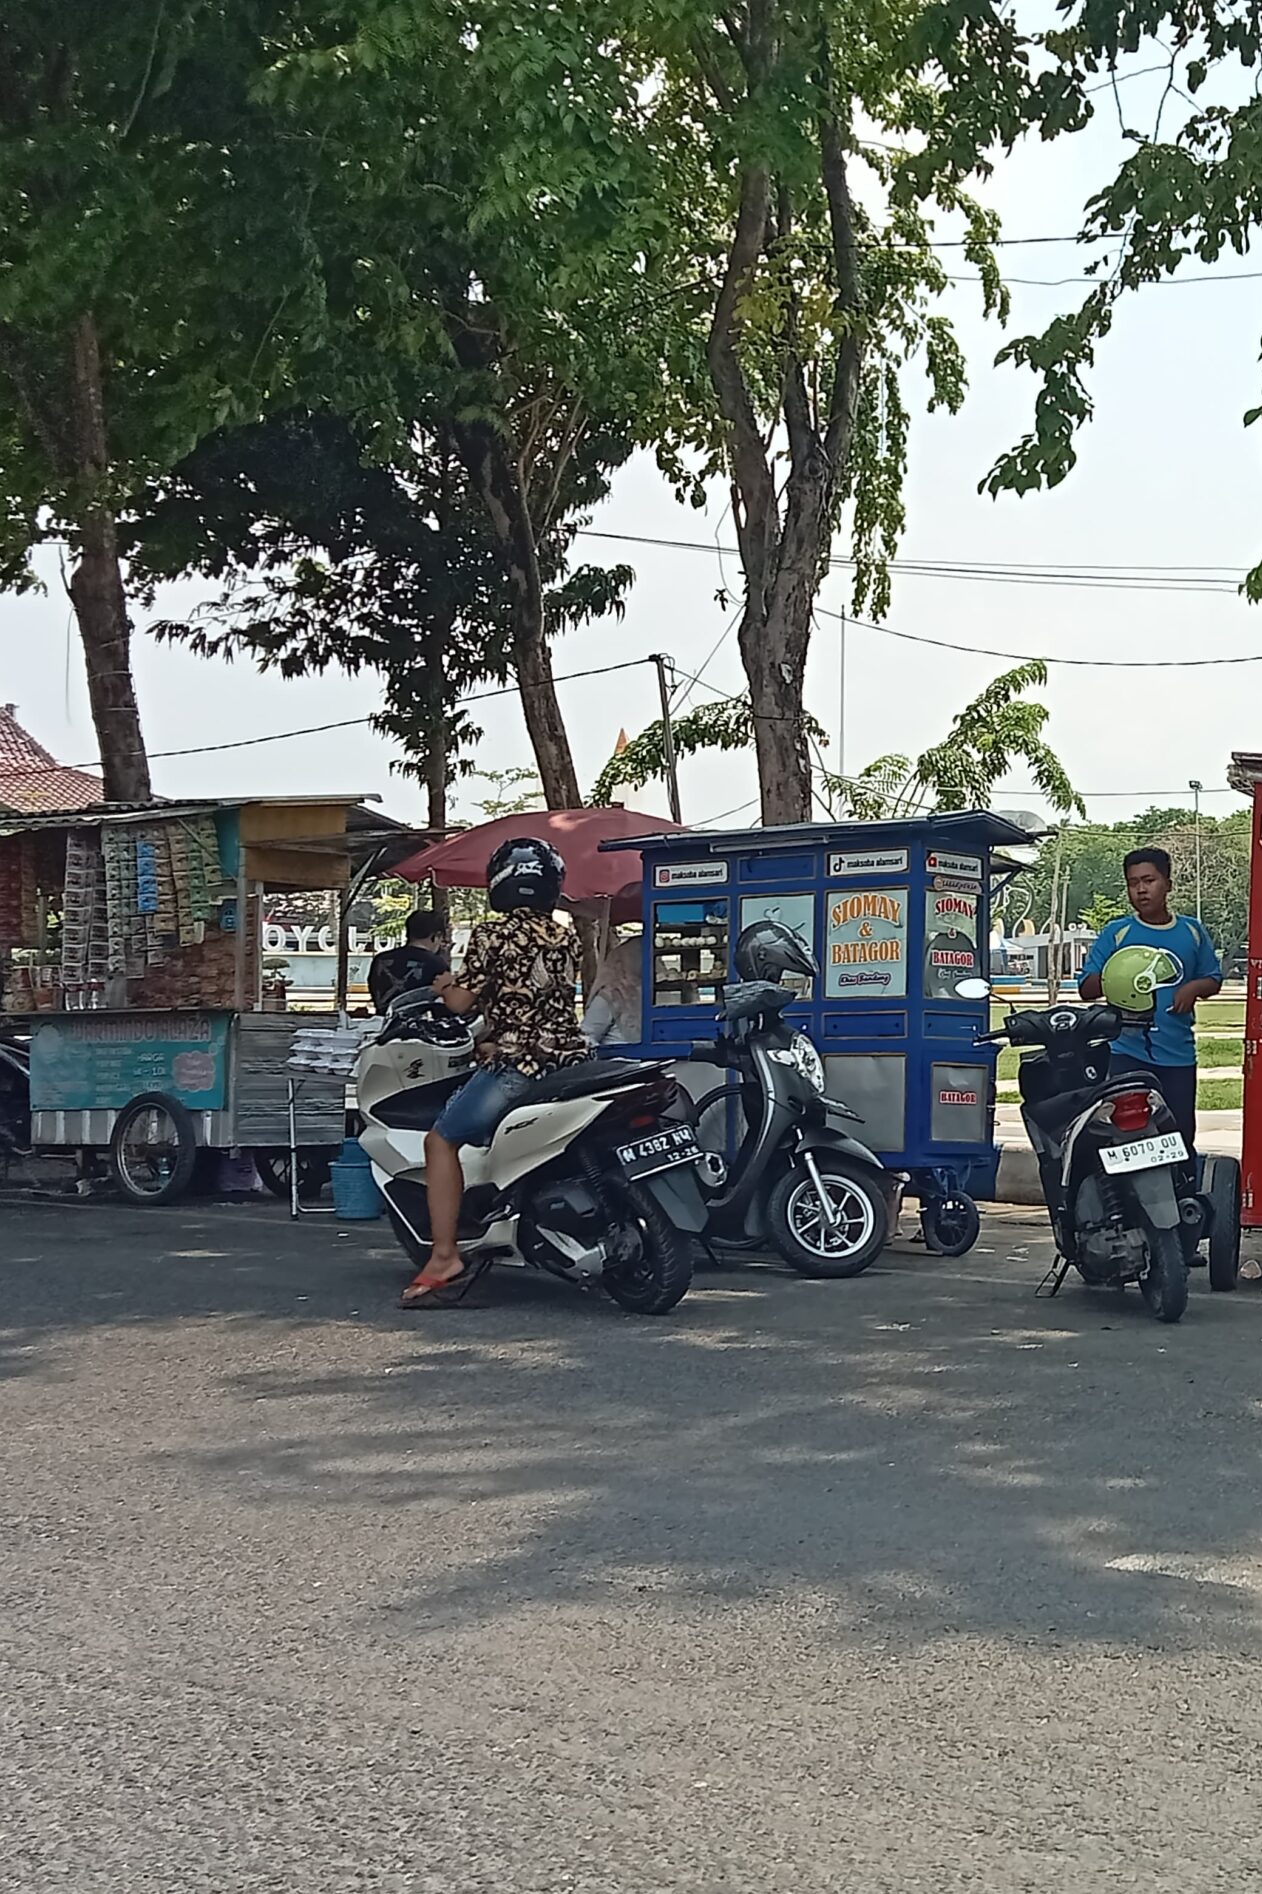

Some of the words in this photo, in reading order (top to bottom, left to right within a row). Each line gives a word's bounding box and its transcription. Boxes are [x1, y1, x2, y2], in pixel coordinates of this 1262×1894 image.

[831, 893, 902, 929] SIOMAY
[934, 897, 977, 919] SIOMAY
[858, 920, 873, 938] &
[831, 939, 901, 965] BATAGOR
[932, 950, 974, 967] BATAGOR
[940, 1091, 976, 1104] BATAGOR
[639, 1137, 671, 1157] 4382
[1122, 1141, 1155, 1158] 6070
